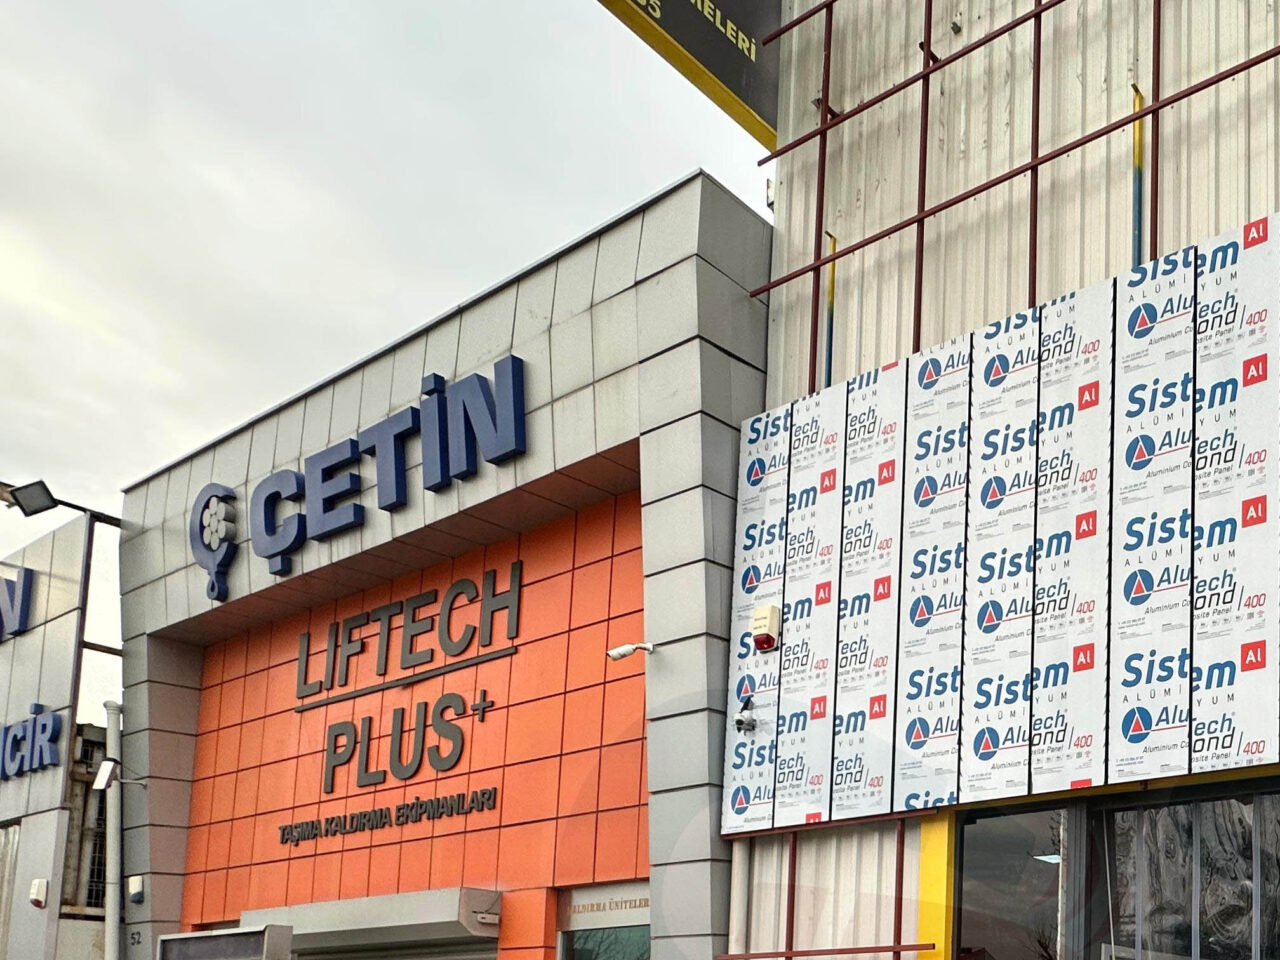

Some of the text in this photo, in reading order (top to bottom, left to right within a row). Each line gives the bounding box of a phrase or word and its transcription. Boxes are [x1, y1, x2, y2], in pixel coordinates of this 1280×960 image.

[250, 354, 526, 577] ÇETİN
[297, 559, 523, 700] LIFTECH
[0, 702, 60, 780] CİR
[278, 787, 497, 846] TAŞIMA KALDIRMA EKİPMANLARI
[130, 931, 142, 946] 52
